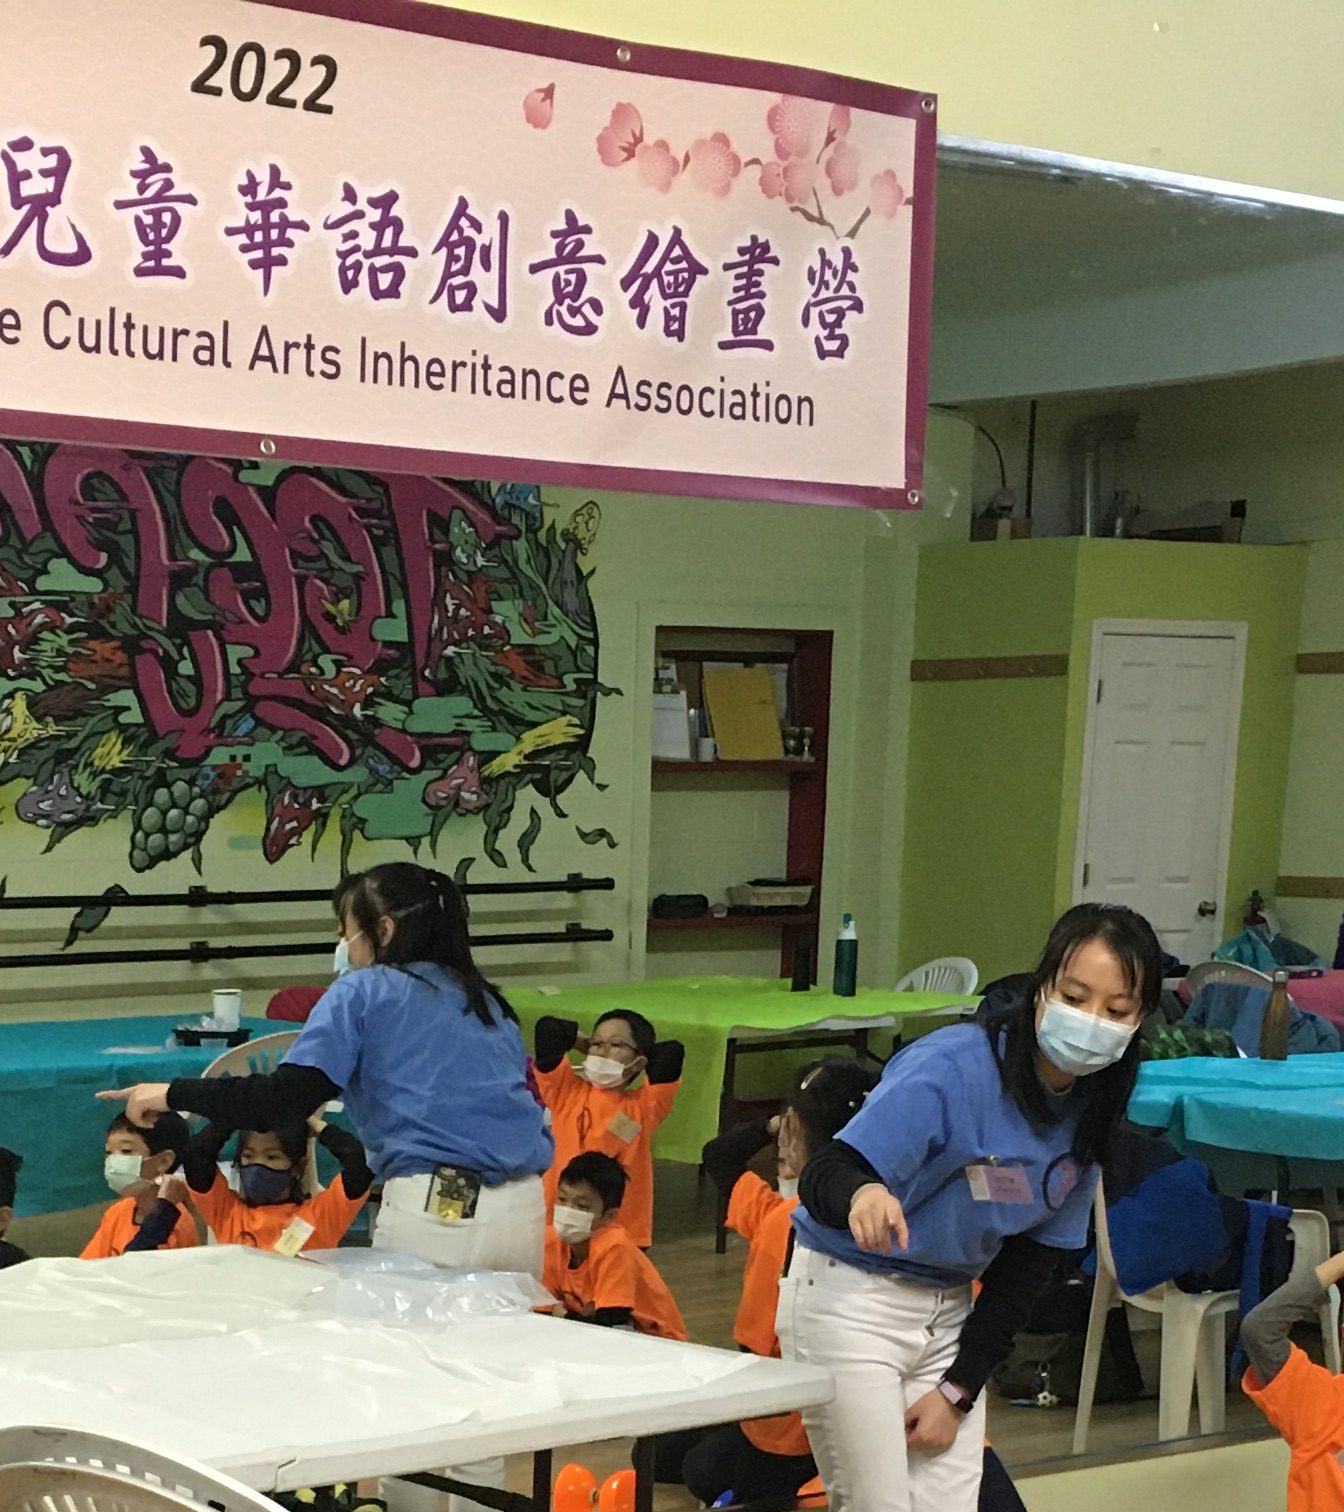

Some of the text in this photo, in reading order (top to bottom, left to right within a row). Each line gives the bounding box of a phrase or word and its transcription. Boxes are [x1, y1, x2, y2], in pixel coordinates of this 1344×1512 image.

[189, 34, 339, 117] 2022
[42, 299, 233, 370] Cultural
[248, 324, 342, 382] Arts
[358, 335, 591, 407] Inheritance
[604, 364, 816, 428] Association
